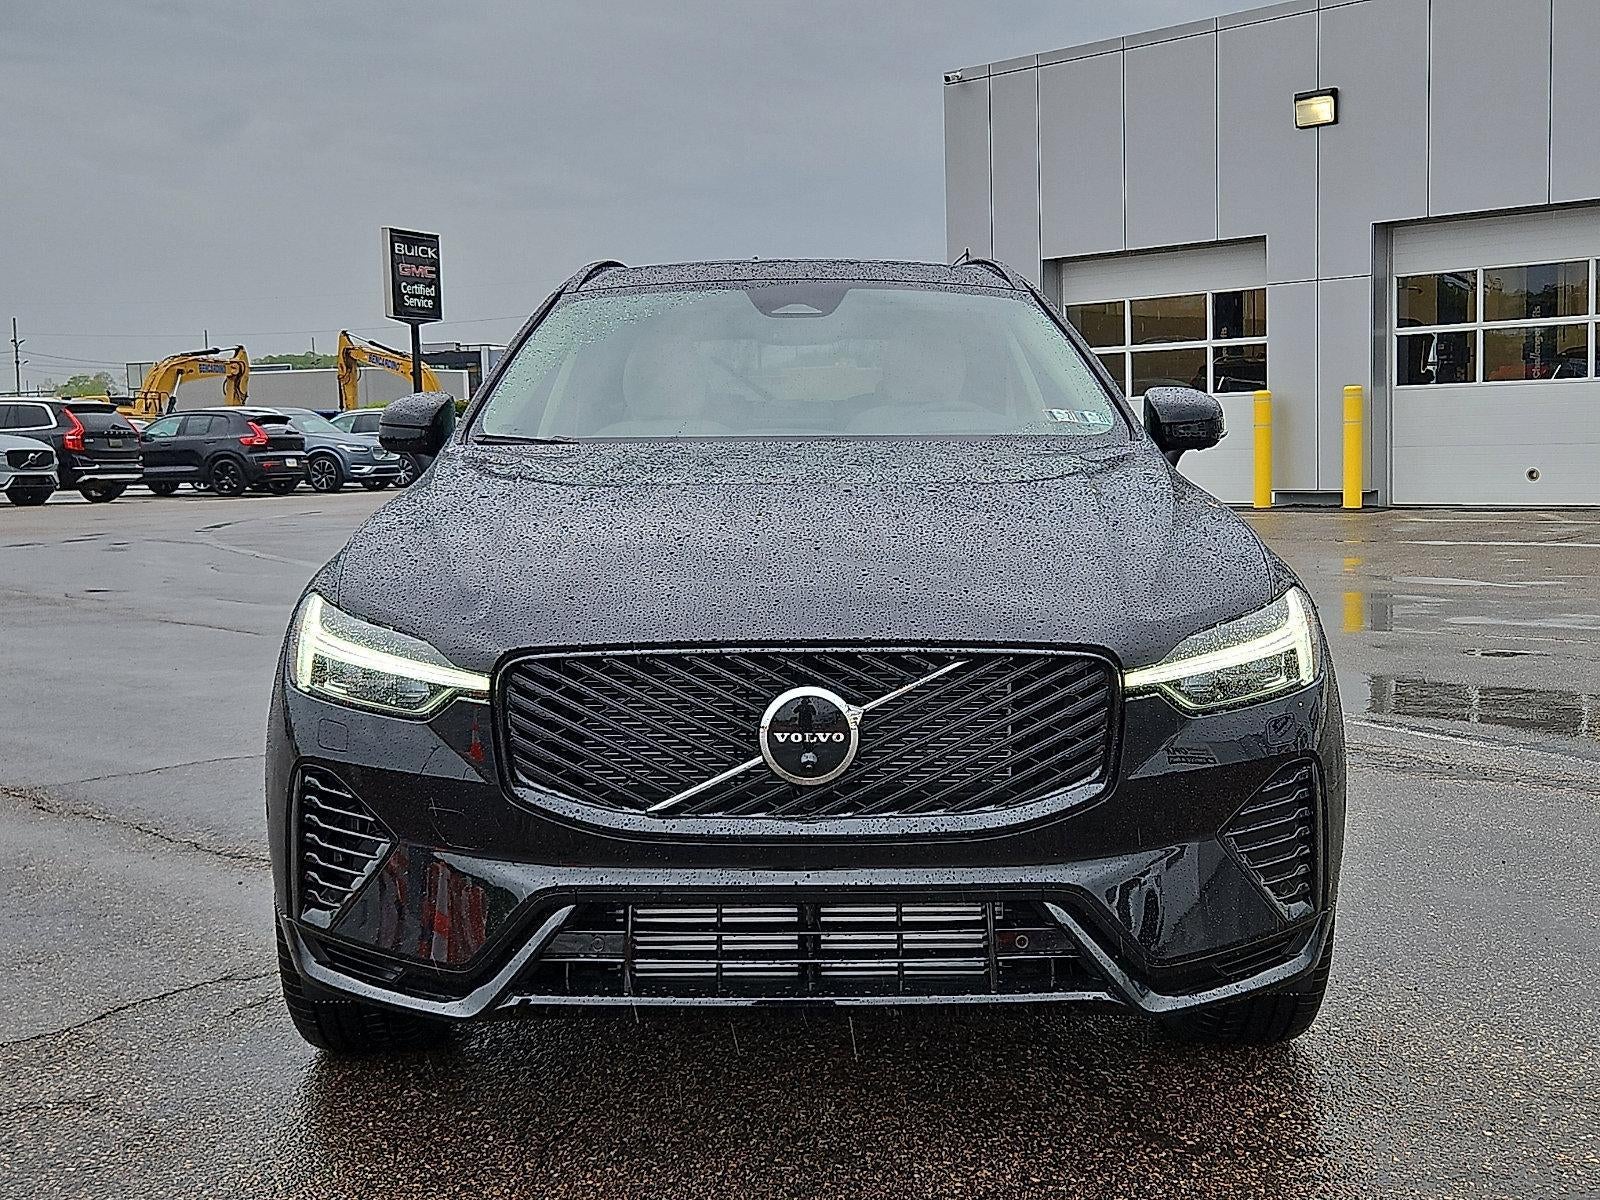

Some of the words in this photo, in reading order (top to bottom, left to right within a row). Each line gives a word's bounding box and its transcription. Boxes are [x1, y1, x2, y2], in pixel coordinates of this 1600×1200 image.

[394, 242, 438, 260] BUICK
[399, 263, 437, 279] GMC
[401, 282, 435, 297] Certified
[403, 295, 433, 309] Service
[773, 732, 845, 743] VOLVO
